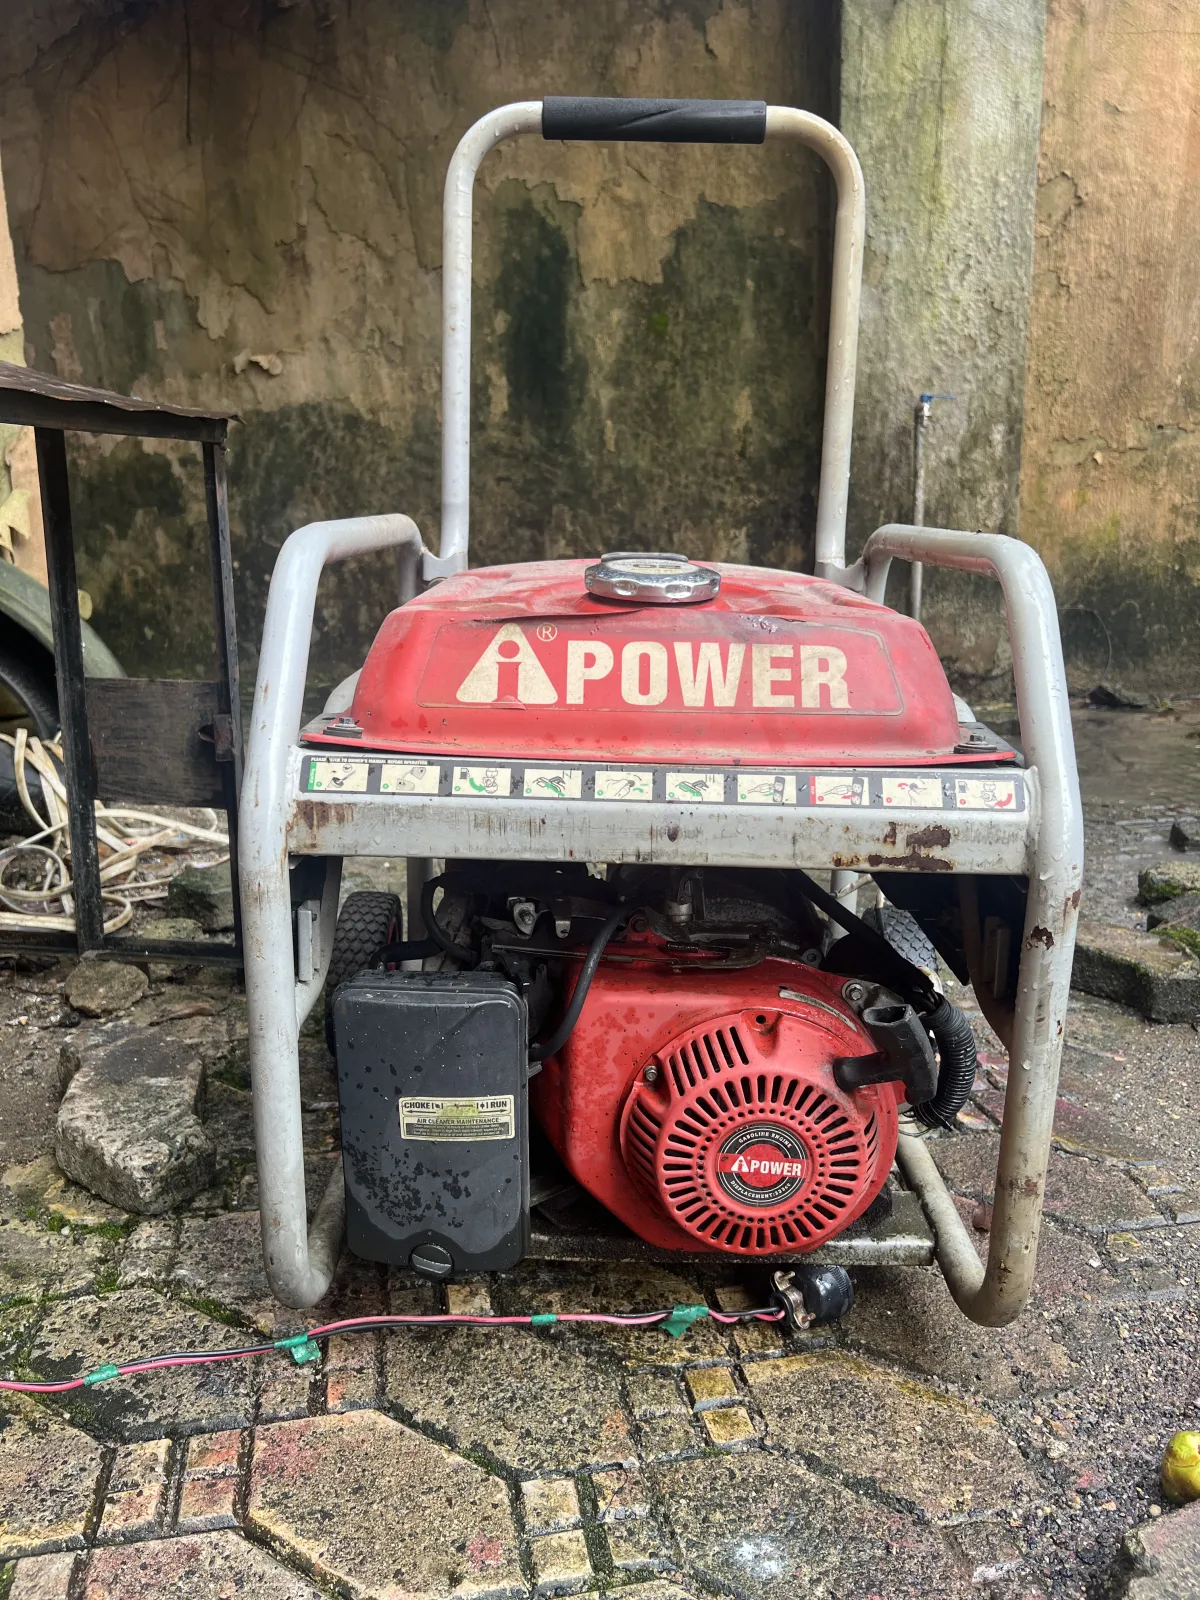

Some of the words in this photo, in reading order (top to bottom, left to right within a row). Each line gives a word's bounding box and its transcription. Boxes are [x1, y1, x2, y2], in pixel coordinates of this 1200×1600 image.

[404, 1101, 430, 1110] CHOKE
[490, 1101, 507, 1109] RUN
[738, 1131, 770, 1143] GASOLINE
[771, 1132, 792, 1148] ENGINE
